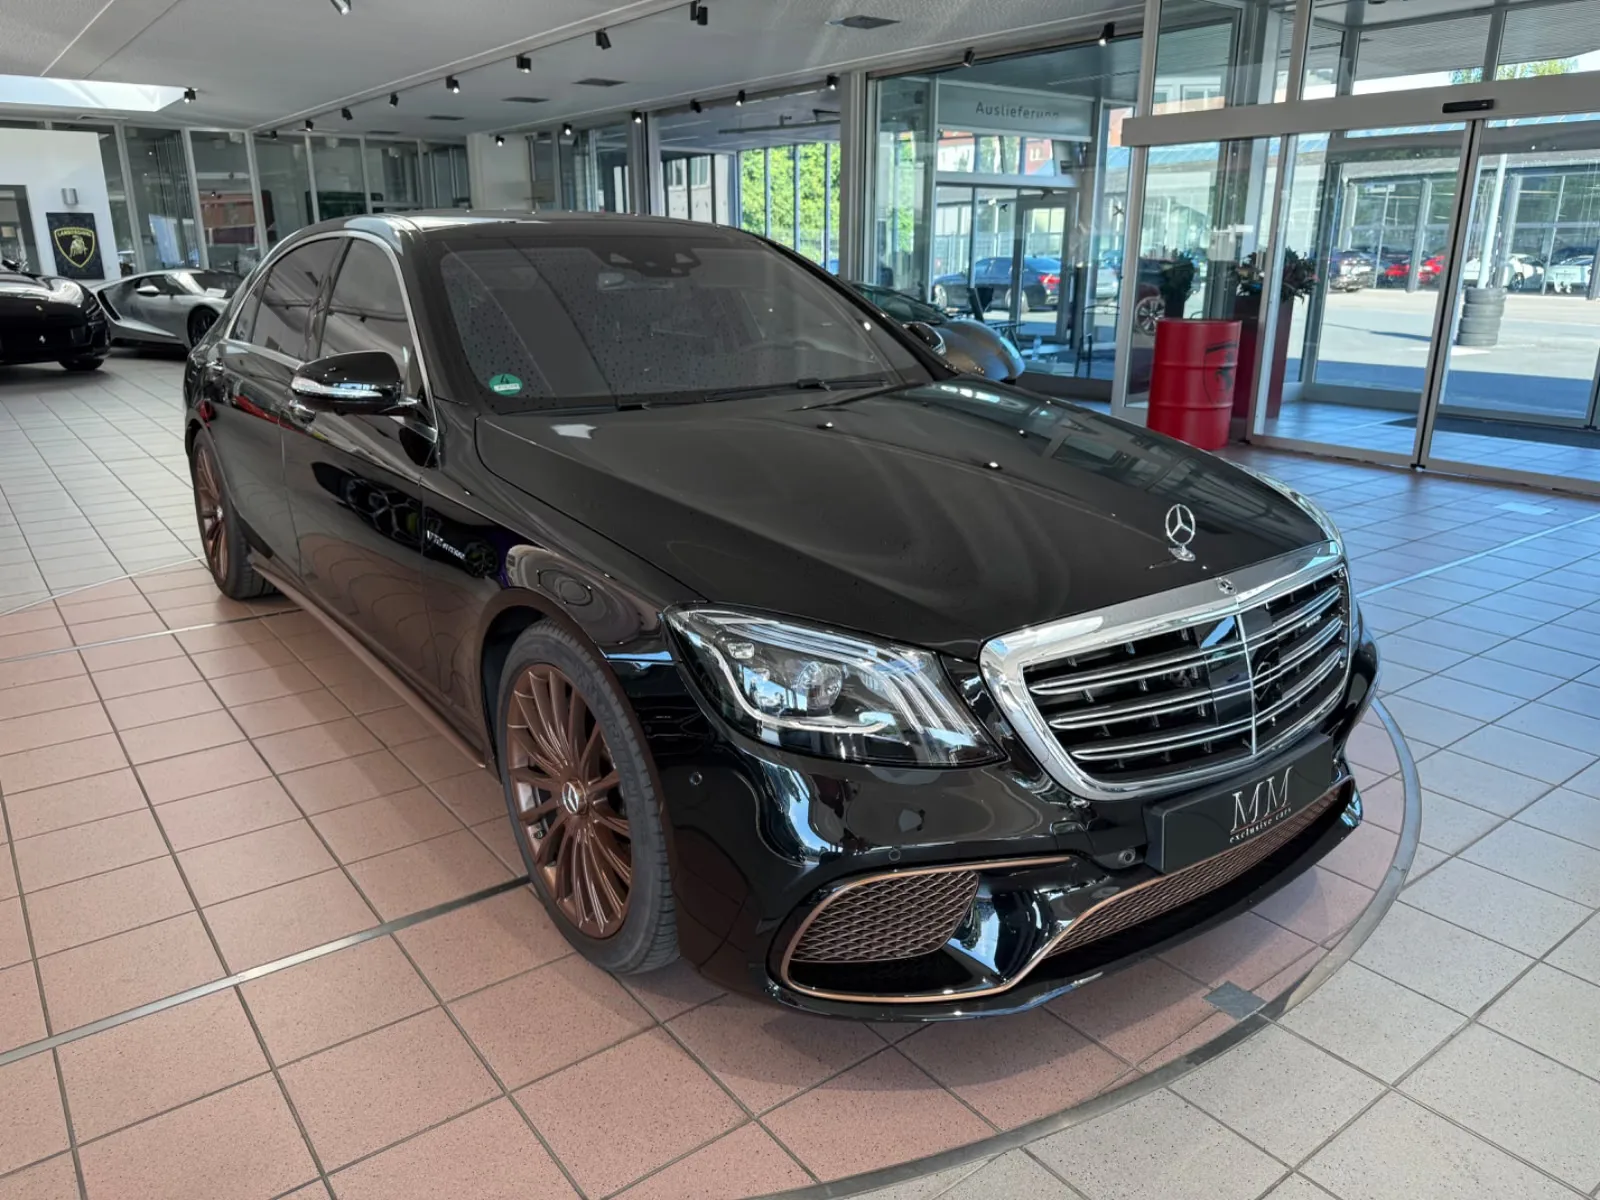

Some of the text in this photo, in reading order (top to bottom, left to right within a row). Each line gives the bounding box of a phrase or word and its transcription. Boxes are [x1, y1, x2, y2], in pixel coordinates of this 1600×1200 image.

[1229, 807, 1292, 843] exclusive cars
[1230, 766, 1293, 833] MM
